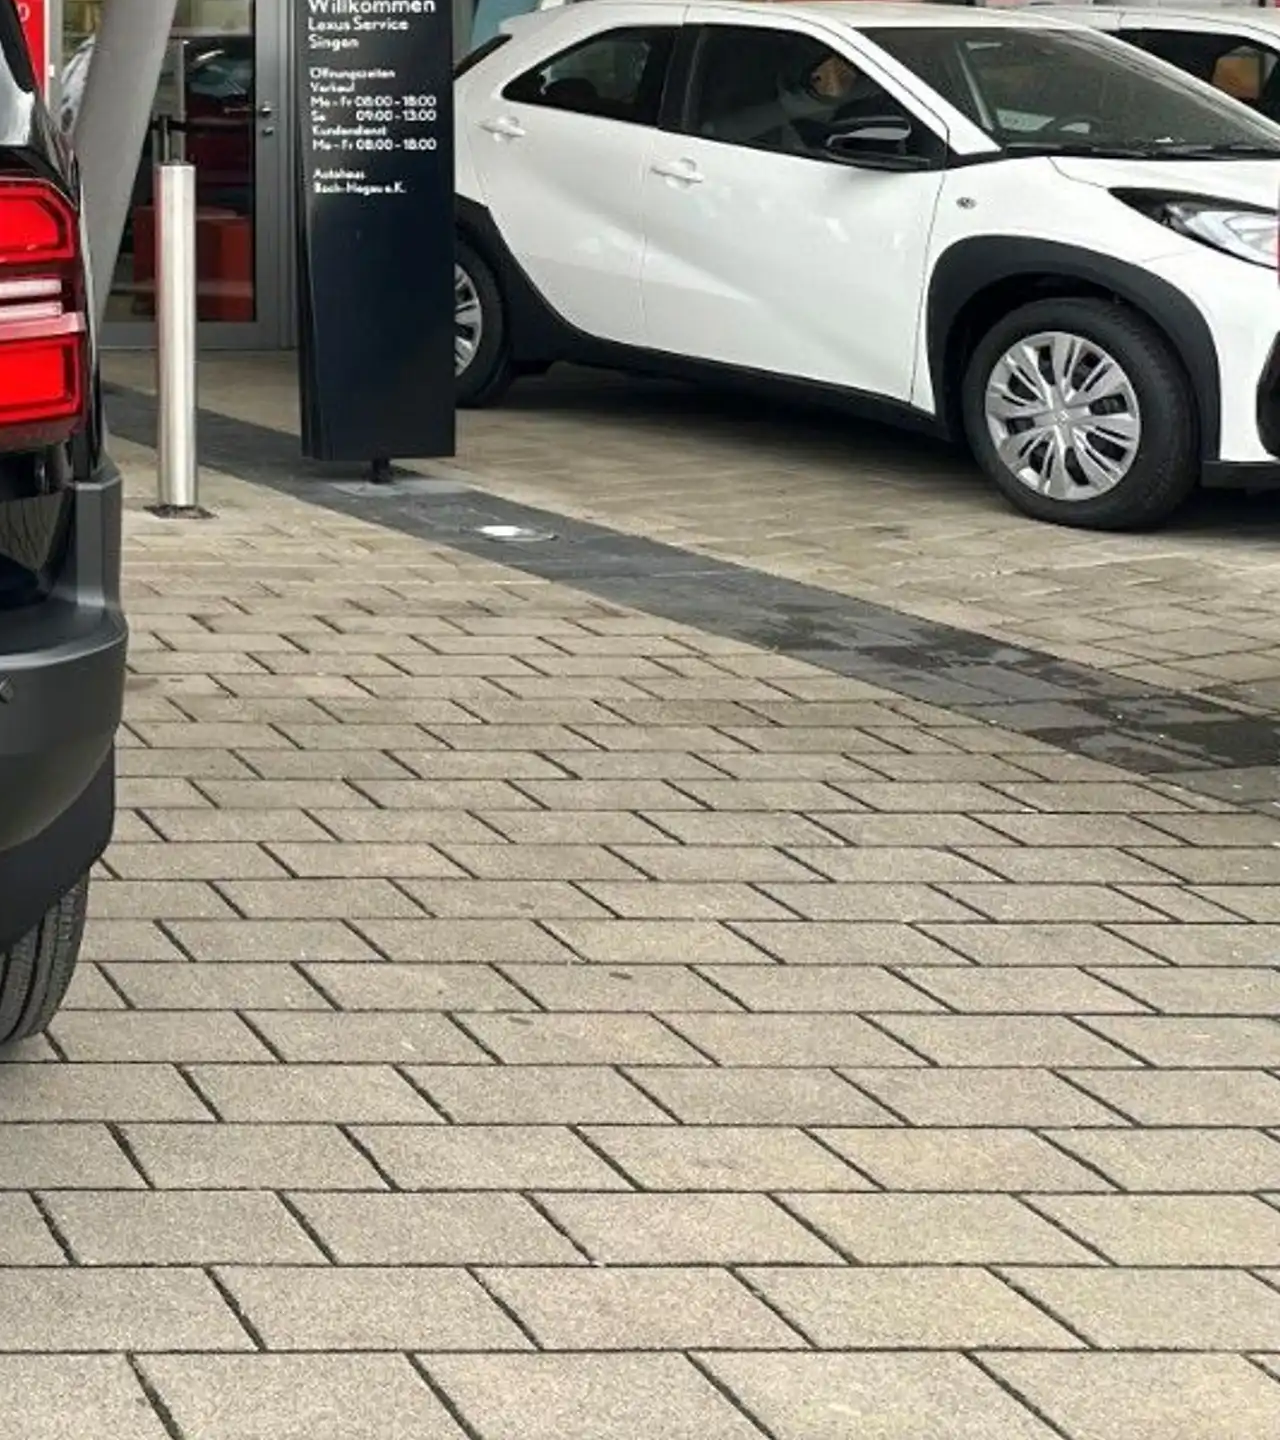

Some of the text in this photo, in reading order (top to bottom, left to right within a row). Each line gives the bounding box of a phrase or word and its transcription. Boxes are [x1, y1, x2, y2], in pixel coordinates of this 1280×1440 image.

[308, 14, 410, 32] Lexus Service
[308, 33, 360, 52] Singen
